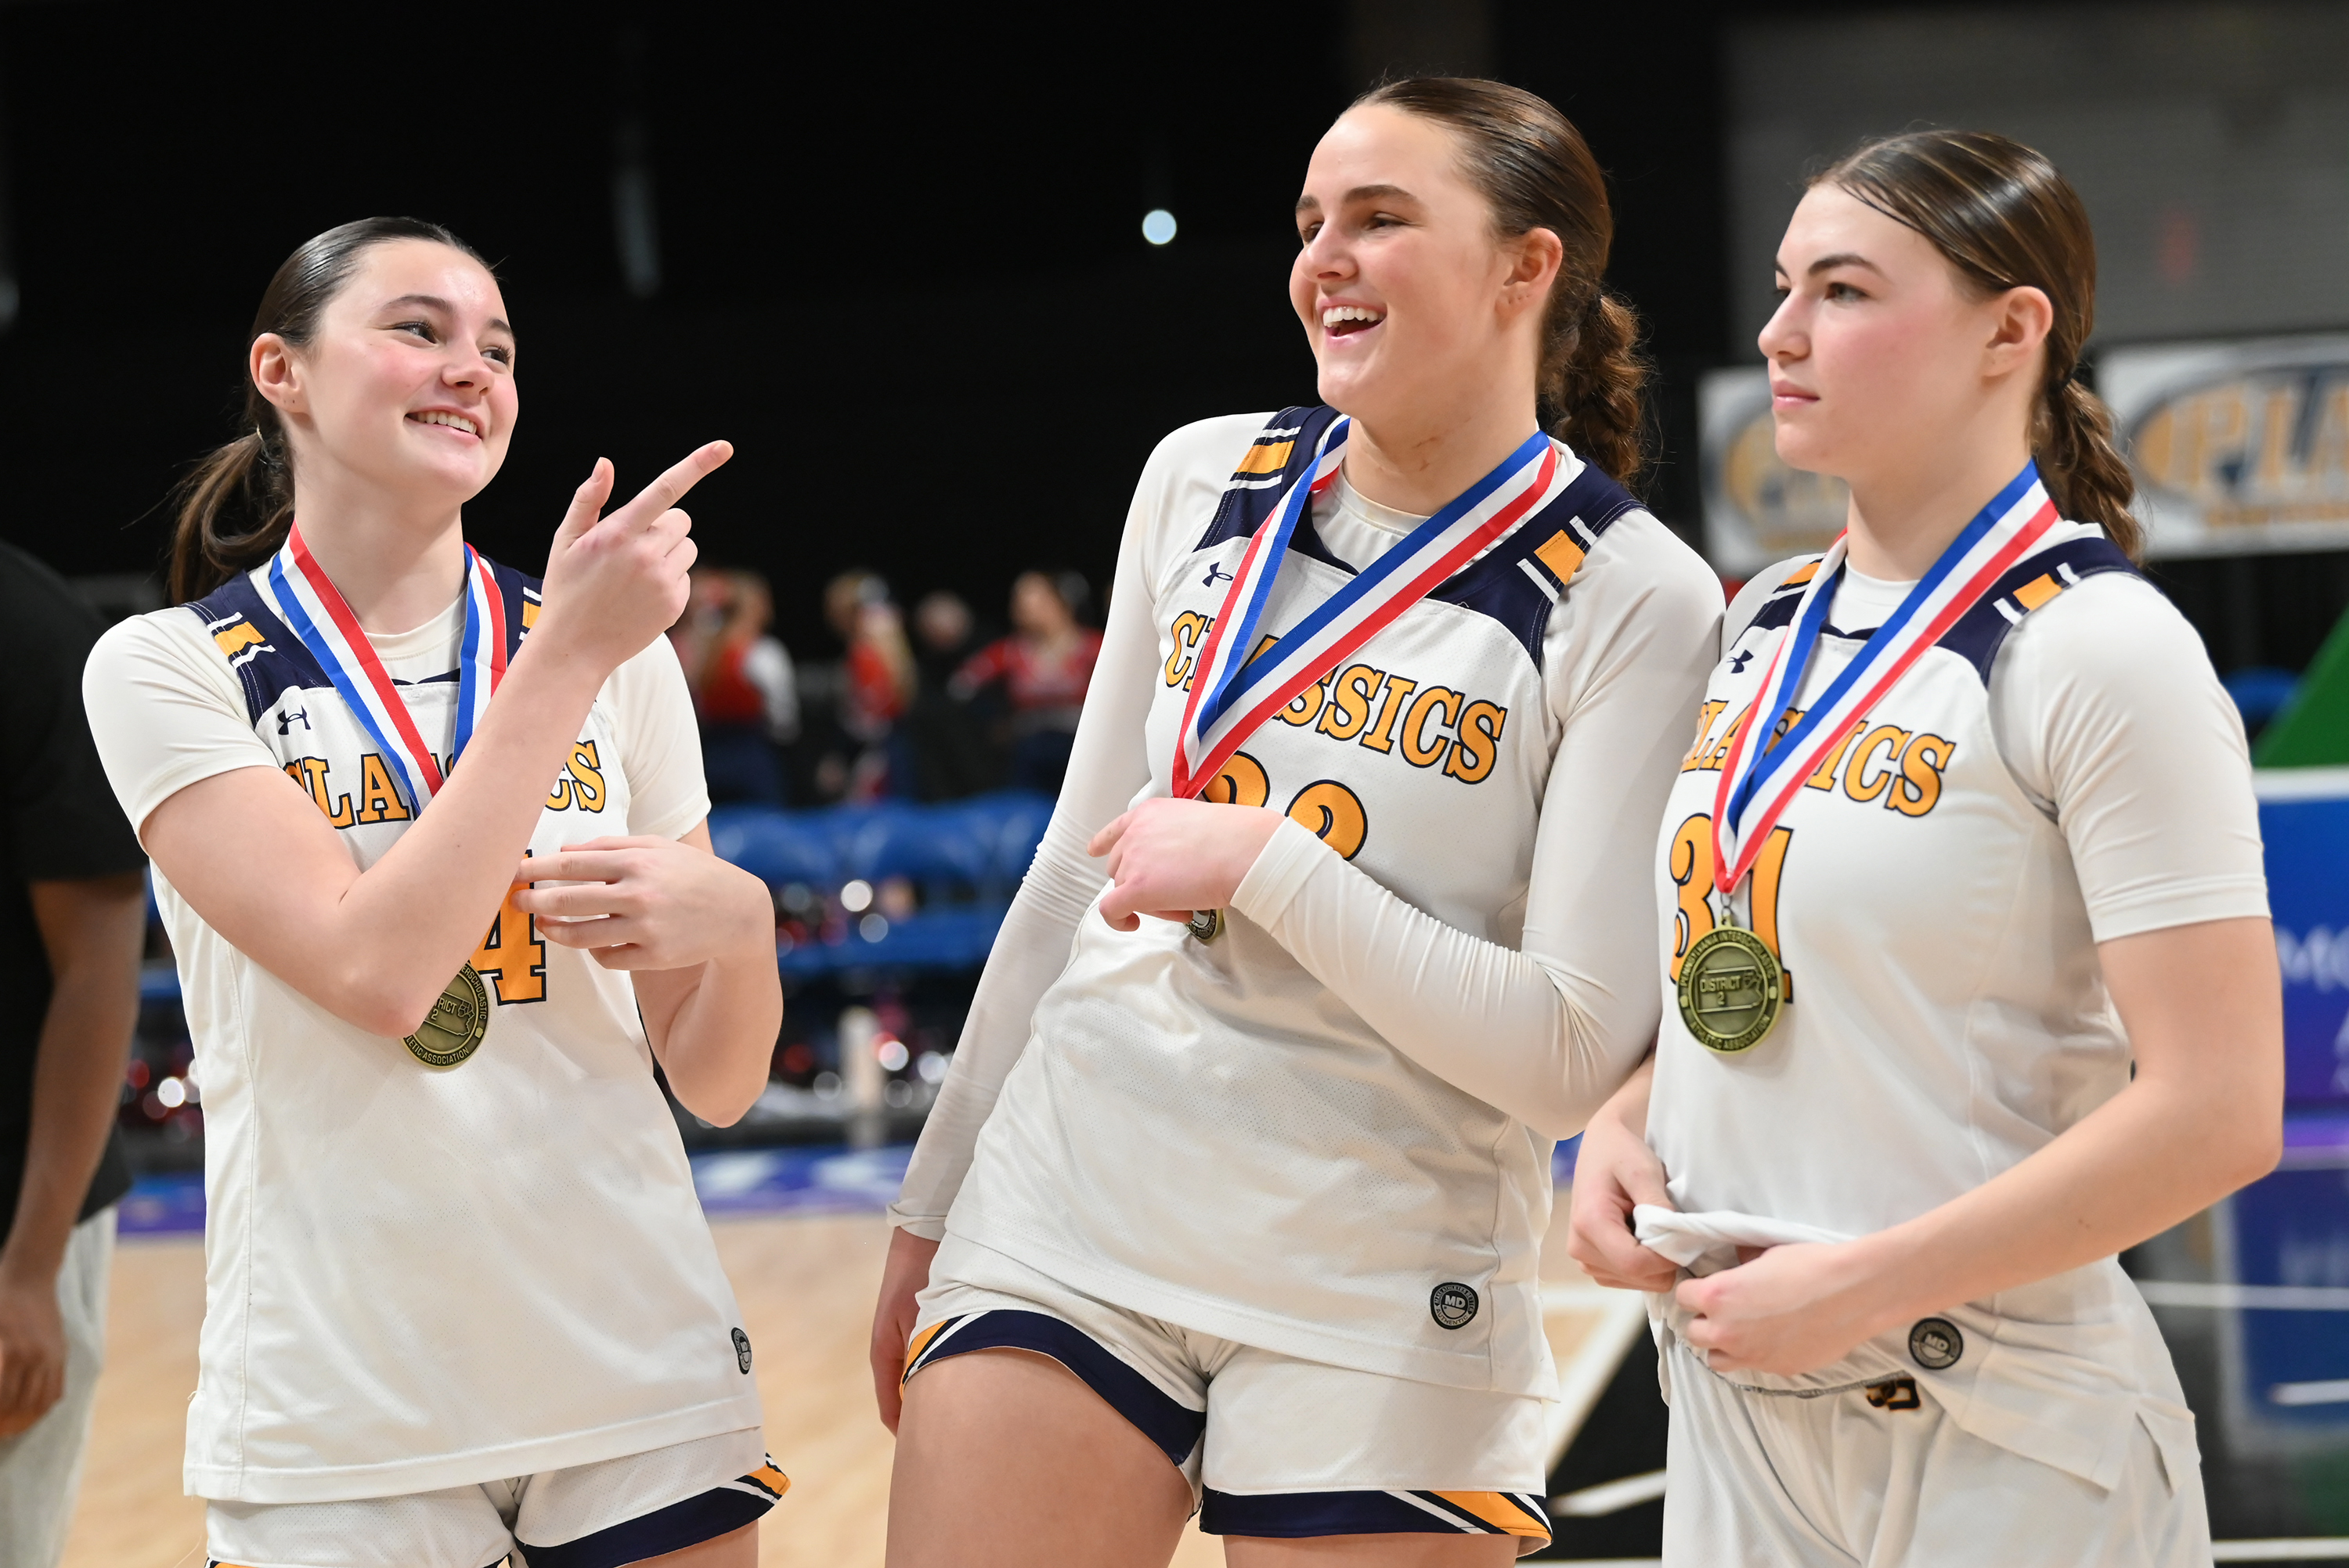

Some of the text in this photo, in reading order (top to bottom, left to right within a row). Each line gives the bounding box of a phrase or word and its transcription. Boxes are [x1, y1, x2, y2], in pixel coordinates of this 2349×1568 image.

[1669, 813, 1794, 1004] 31
[461, 964, 487, 1020] ERSCHOLASTIC
[1699, 975, 1741, 993] DISTRICT
[437, 997, 457, 1015] RICT
[1716, 991, 1726, 1006] 2
[431, 1008, 439, 1021] 2
[406, 1035, 470, 1065] LETIC ASSOCIATION
[1445, 1295, 1466, 1308] MD
[1435, 1308, 1469, 1325] AUTHENTIC
